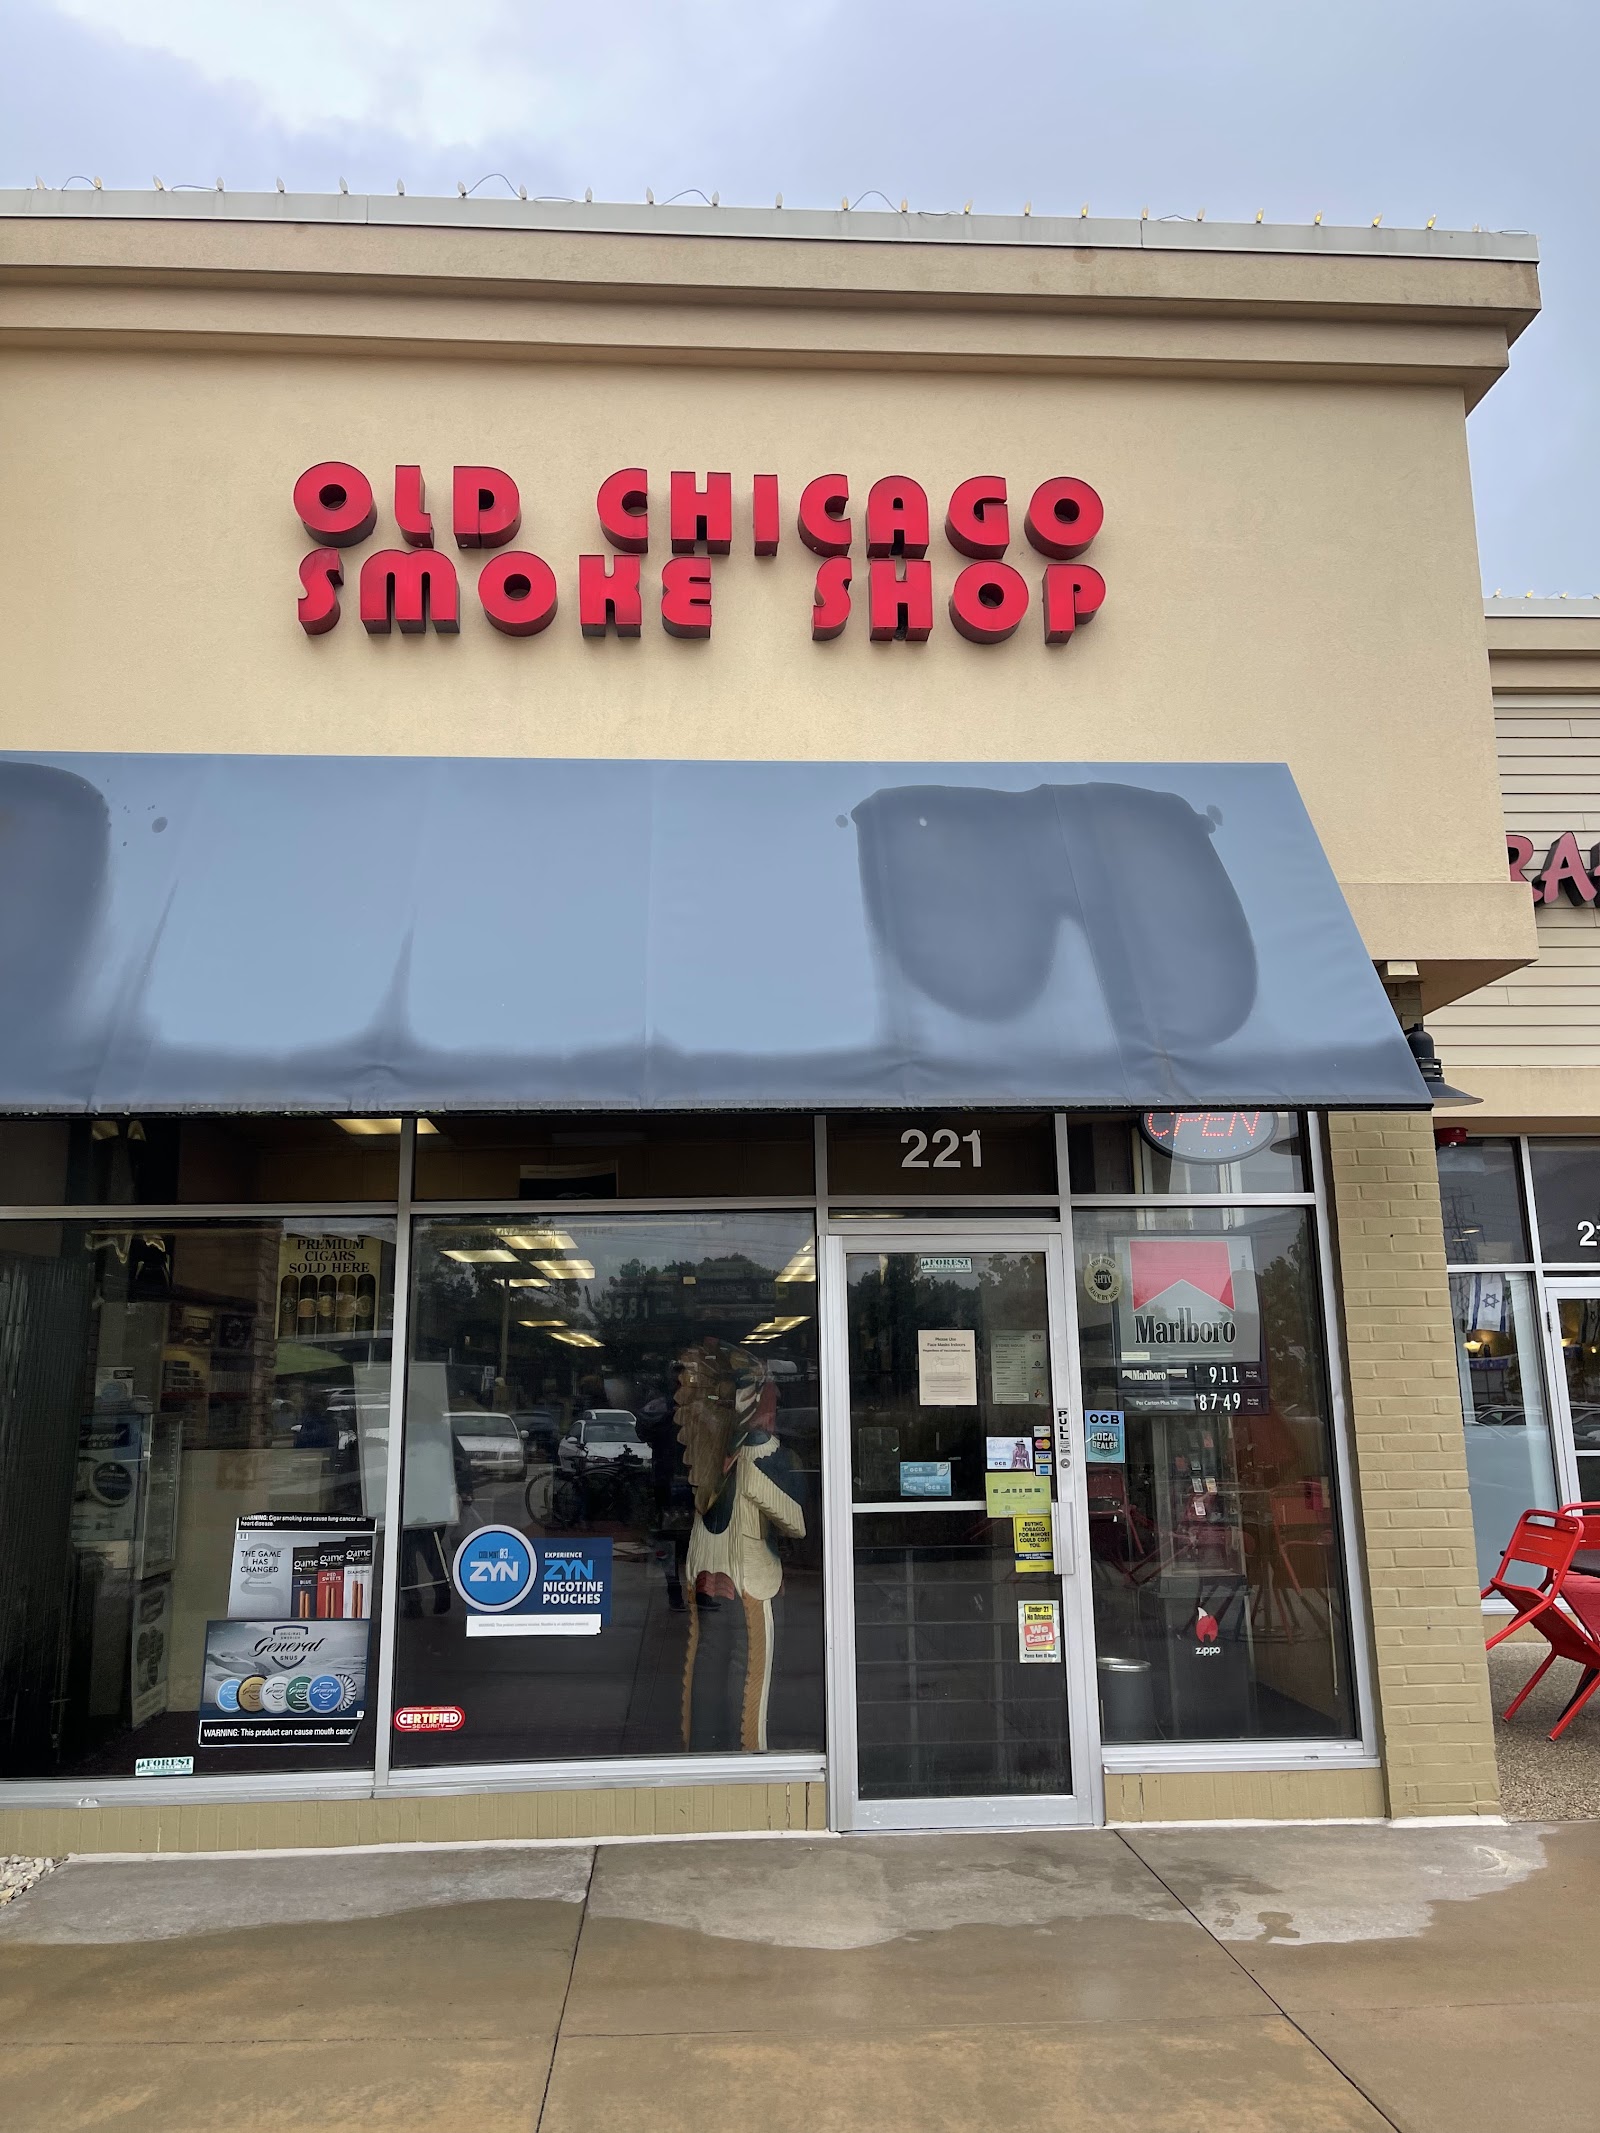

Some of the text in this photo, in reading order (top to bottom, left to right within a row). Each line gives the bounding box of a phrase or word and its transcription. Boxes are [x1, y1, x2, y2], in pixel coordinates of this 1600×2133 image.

[293, 461, 1105, 560] OLD CHICAGO
[297, 547, 1107, 645] SMOKE SHOP
[900, 1129, 983, 1168] 221
[1577, 1220, 1600, 1246] 2
[297, 1239, 365, 1250] PREMIUM
[305, 1250, 356, 1261] CIGARS
[289, 1262, 370, 1274] SOLD HERE
[1134, 1307, 1236, 1344] Marlboro
[1132, 1370, 1166, 1381] Marlboro
[1090, 1414, 1119, 1424] OCB
[1058, 1411, 1069, 1439] PULL
[1092, 1432, 1118, 1441] LOCAL
[1092, 1441, 1118, 1450] DEALER
[241, 1550, 281, 1558] THE GAME
[346, 1549, 371, 1562] game
[294, 1559, 318, 1572] game
[320, 1554, 344, 1566] game
[469, 1561, 518, 1582] ZYN
[543, 1559, 593, 1580] ZYN
[543, 1581, 604, 1592] NICOTINE
[542, 1593, 600, 1604] POUCHES
[1030, 1625, 1048, 1634] We
[1026, 1632, 1053, 1643] Card
[248, 1637, 326, 1657] General
[1195, 1647, 1220, 1656] zippo
[311, 1687, 339, 1695] General
[399, 1713, 458, 1724] CERTIFIED
[204, 1729, 239, 1738] WARNING:
[240, 1728, 254, 1736] This
[255, 1728, 280, 1737] product
[314, 1727, 334, 1735] mouth
[147, 1758, 192, 1766] FOREST
